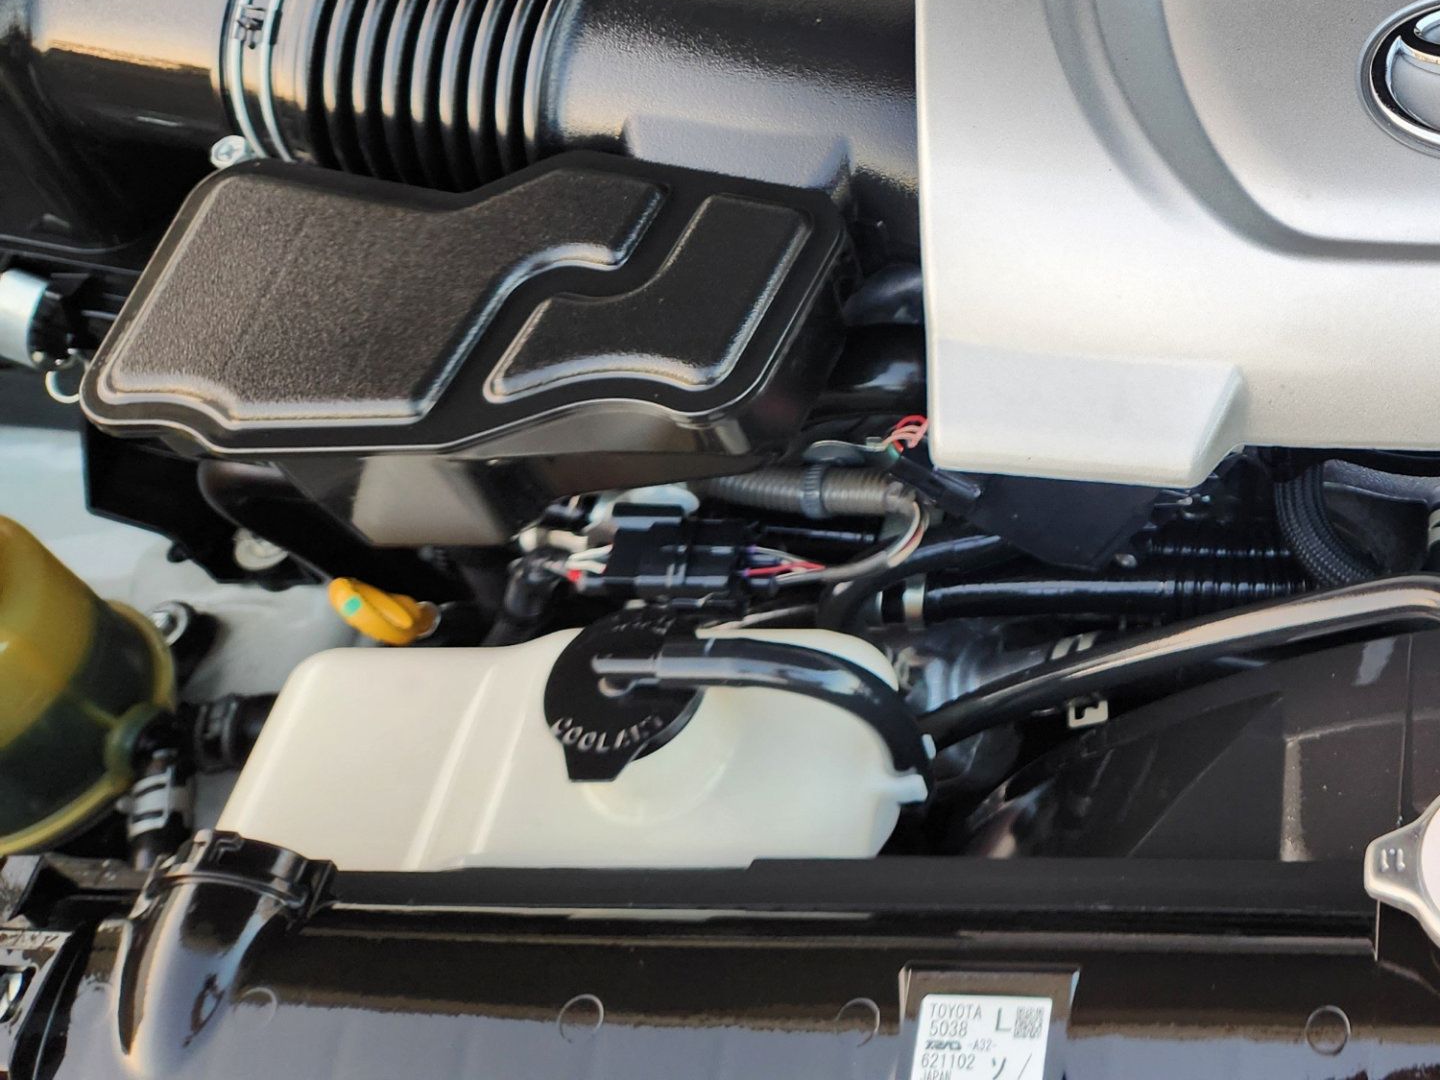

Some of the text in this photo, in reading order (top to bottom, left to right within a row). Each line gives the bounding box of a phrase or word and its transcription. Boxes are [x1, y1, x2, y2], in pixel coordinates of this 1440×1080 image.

[930, 1003, 982, 1020] TOYOTA
[995, 1006, 1012, 1032] L
[930, 1020, 969, 1038] 5038
[921, 1053, 976, 1071] 621102
